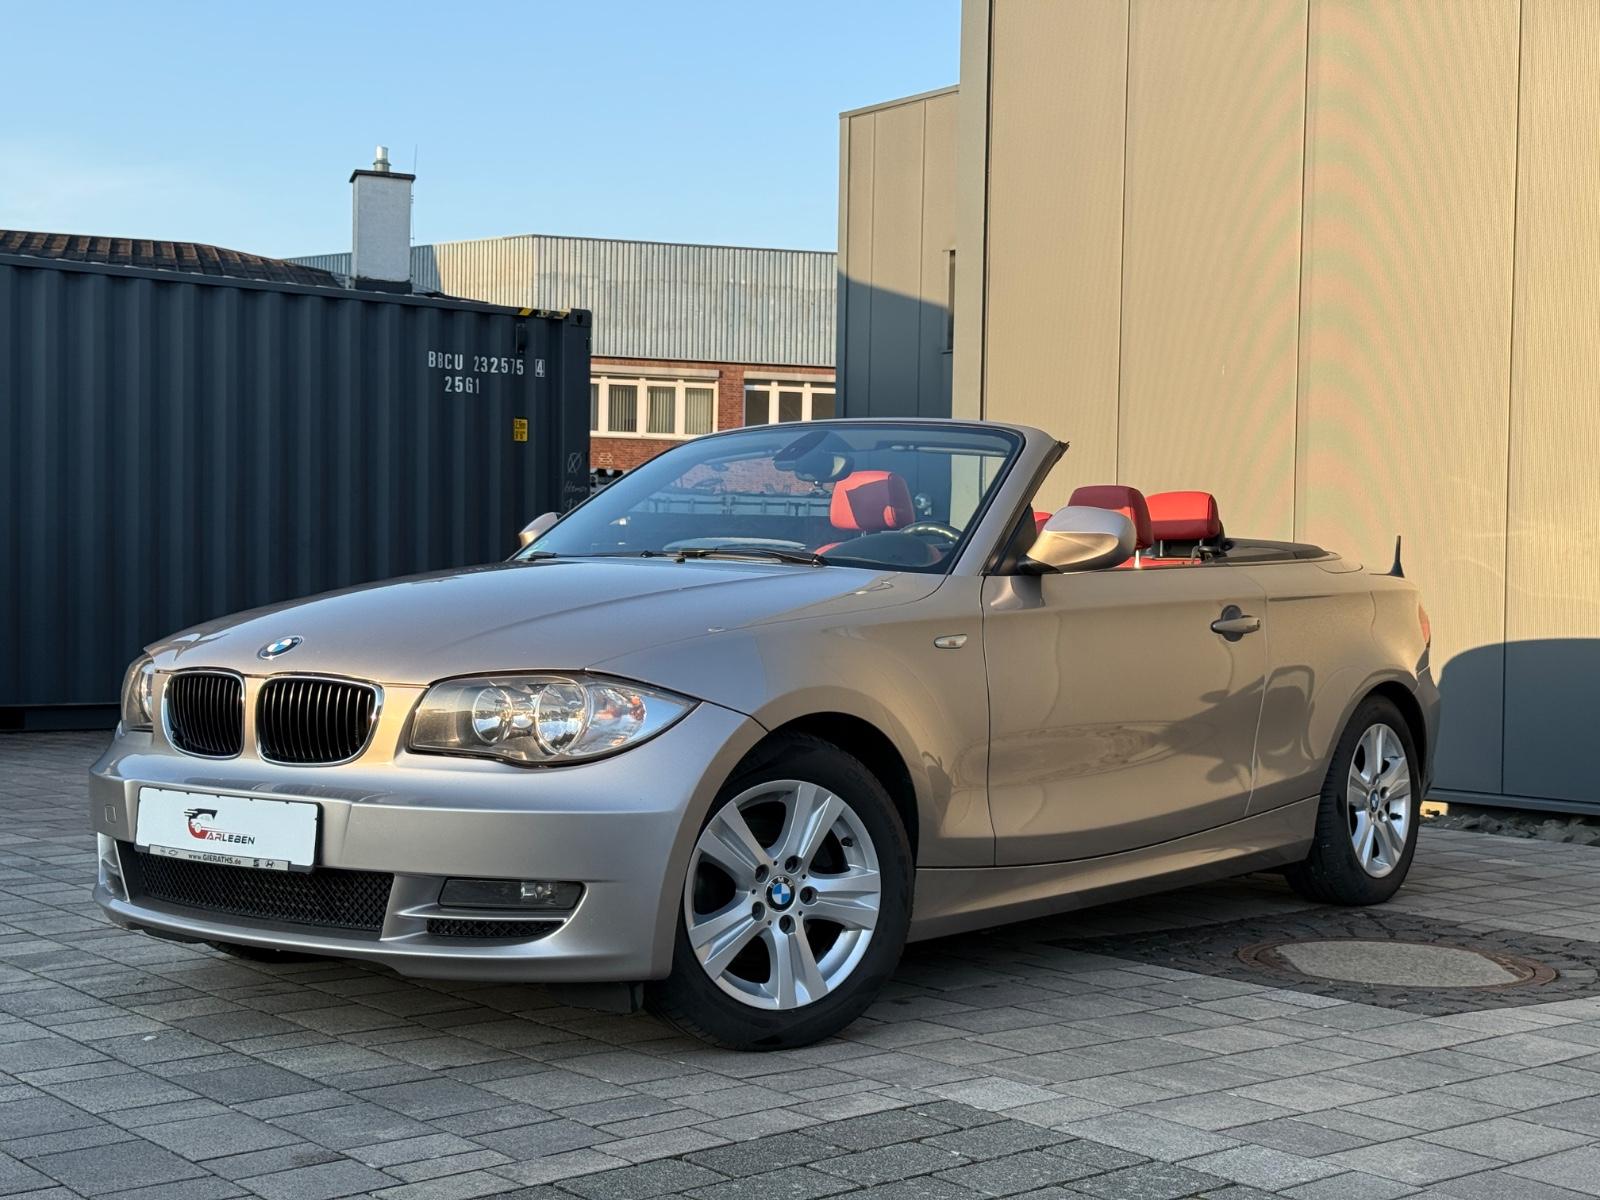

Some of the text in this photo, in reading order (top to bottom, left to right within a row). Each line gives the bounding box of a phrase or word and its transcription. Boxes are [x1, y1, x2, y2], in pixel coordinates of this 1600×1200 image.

[428, 351, 545, 377] BBCU 232575 4
[444, 376, 480, 394] 25G1
